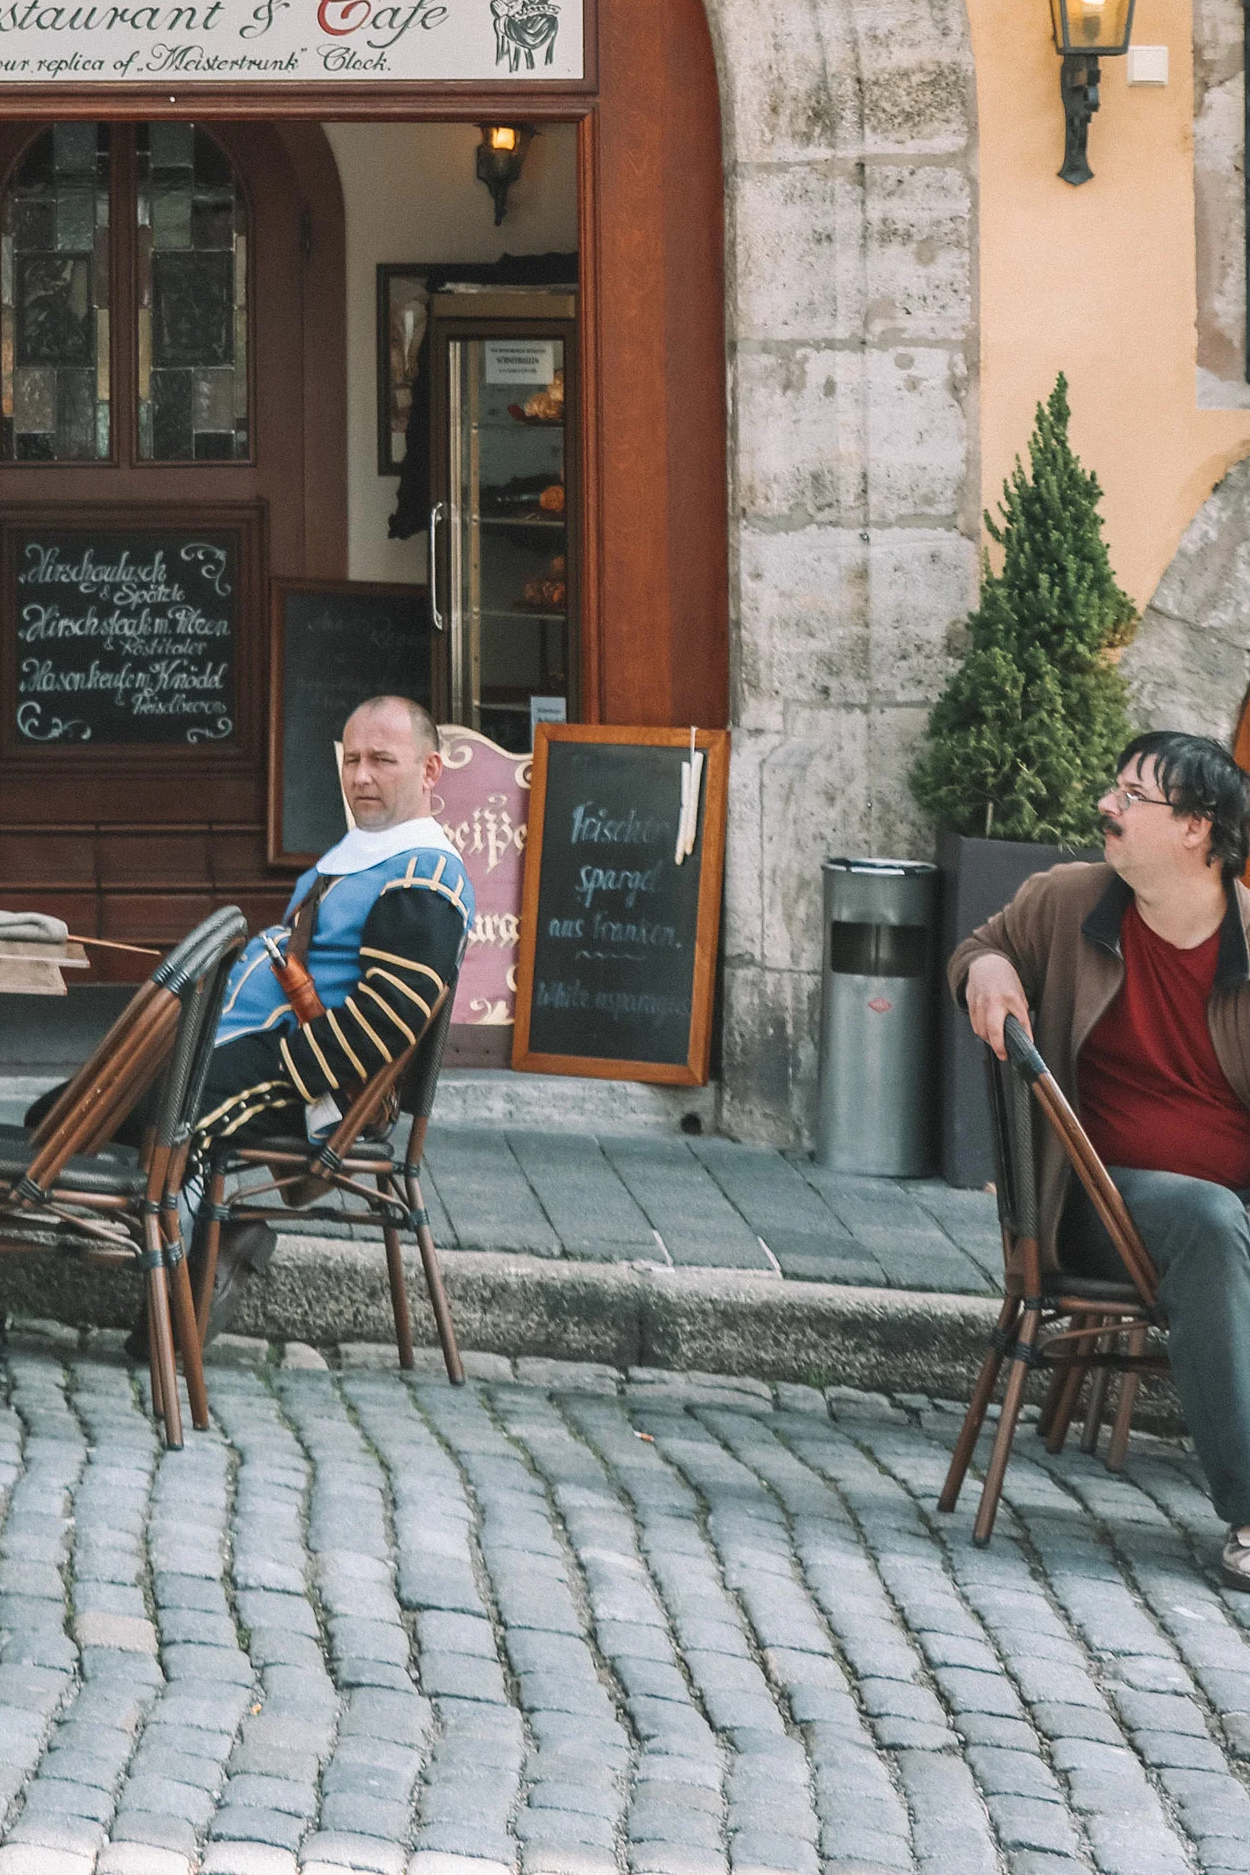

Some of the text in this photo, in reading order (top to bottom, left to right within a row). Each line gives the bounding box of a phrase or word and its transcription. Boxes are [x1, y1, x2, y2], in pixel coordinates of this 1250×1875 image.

[37, 50, 106, 79] replica
[112, 50, 140, 78] of
[317, 43, 391, 72] Clock.
